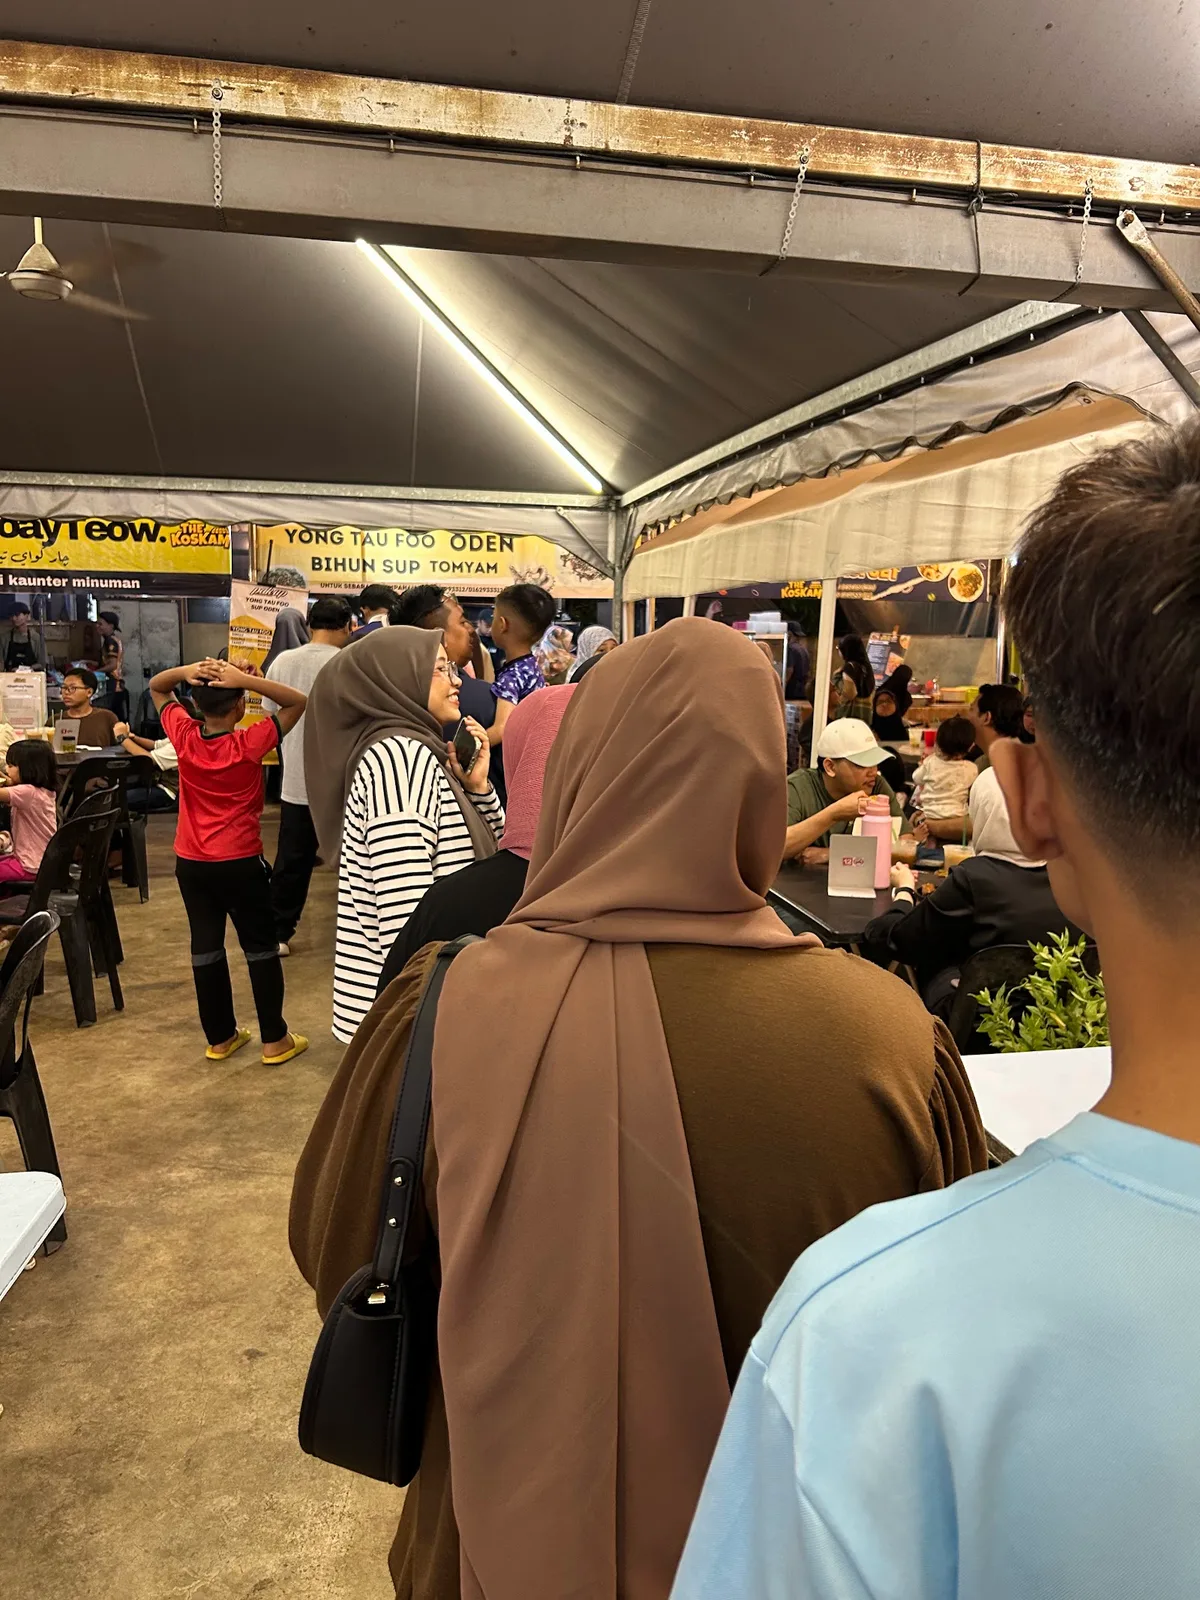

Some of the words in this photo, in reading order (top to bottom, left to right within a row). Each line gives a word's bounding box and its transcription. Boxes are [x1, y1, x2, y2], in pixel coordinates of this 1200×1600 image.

[181, 523, 204, 534] THE
[285, 529, 344, 545] YONG
[351, 531, 388, 547] TAU
[396, 533, 435, 548] FOO
[450, 533, 514, 552] ODEN
[311, 556, 375, 573] BIHUN
[383, 559, 420, 574] SUP
[430, 561, 498, 574] TOMYAM
[8, 574, 68, 587] kaunter
[72, 576, 140, 589] minuman
[788, 581, 804, 589] THE
